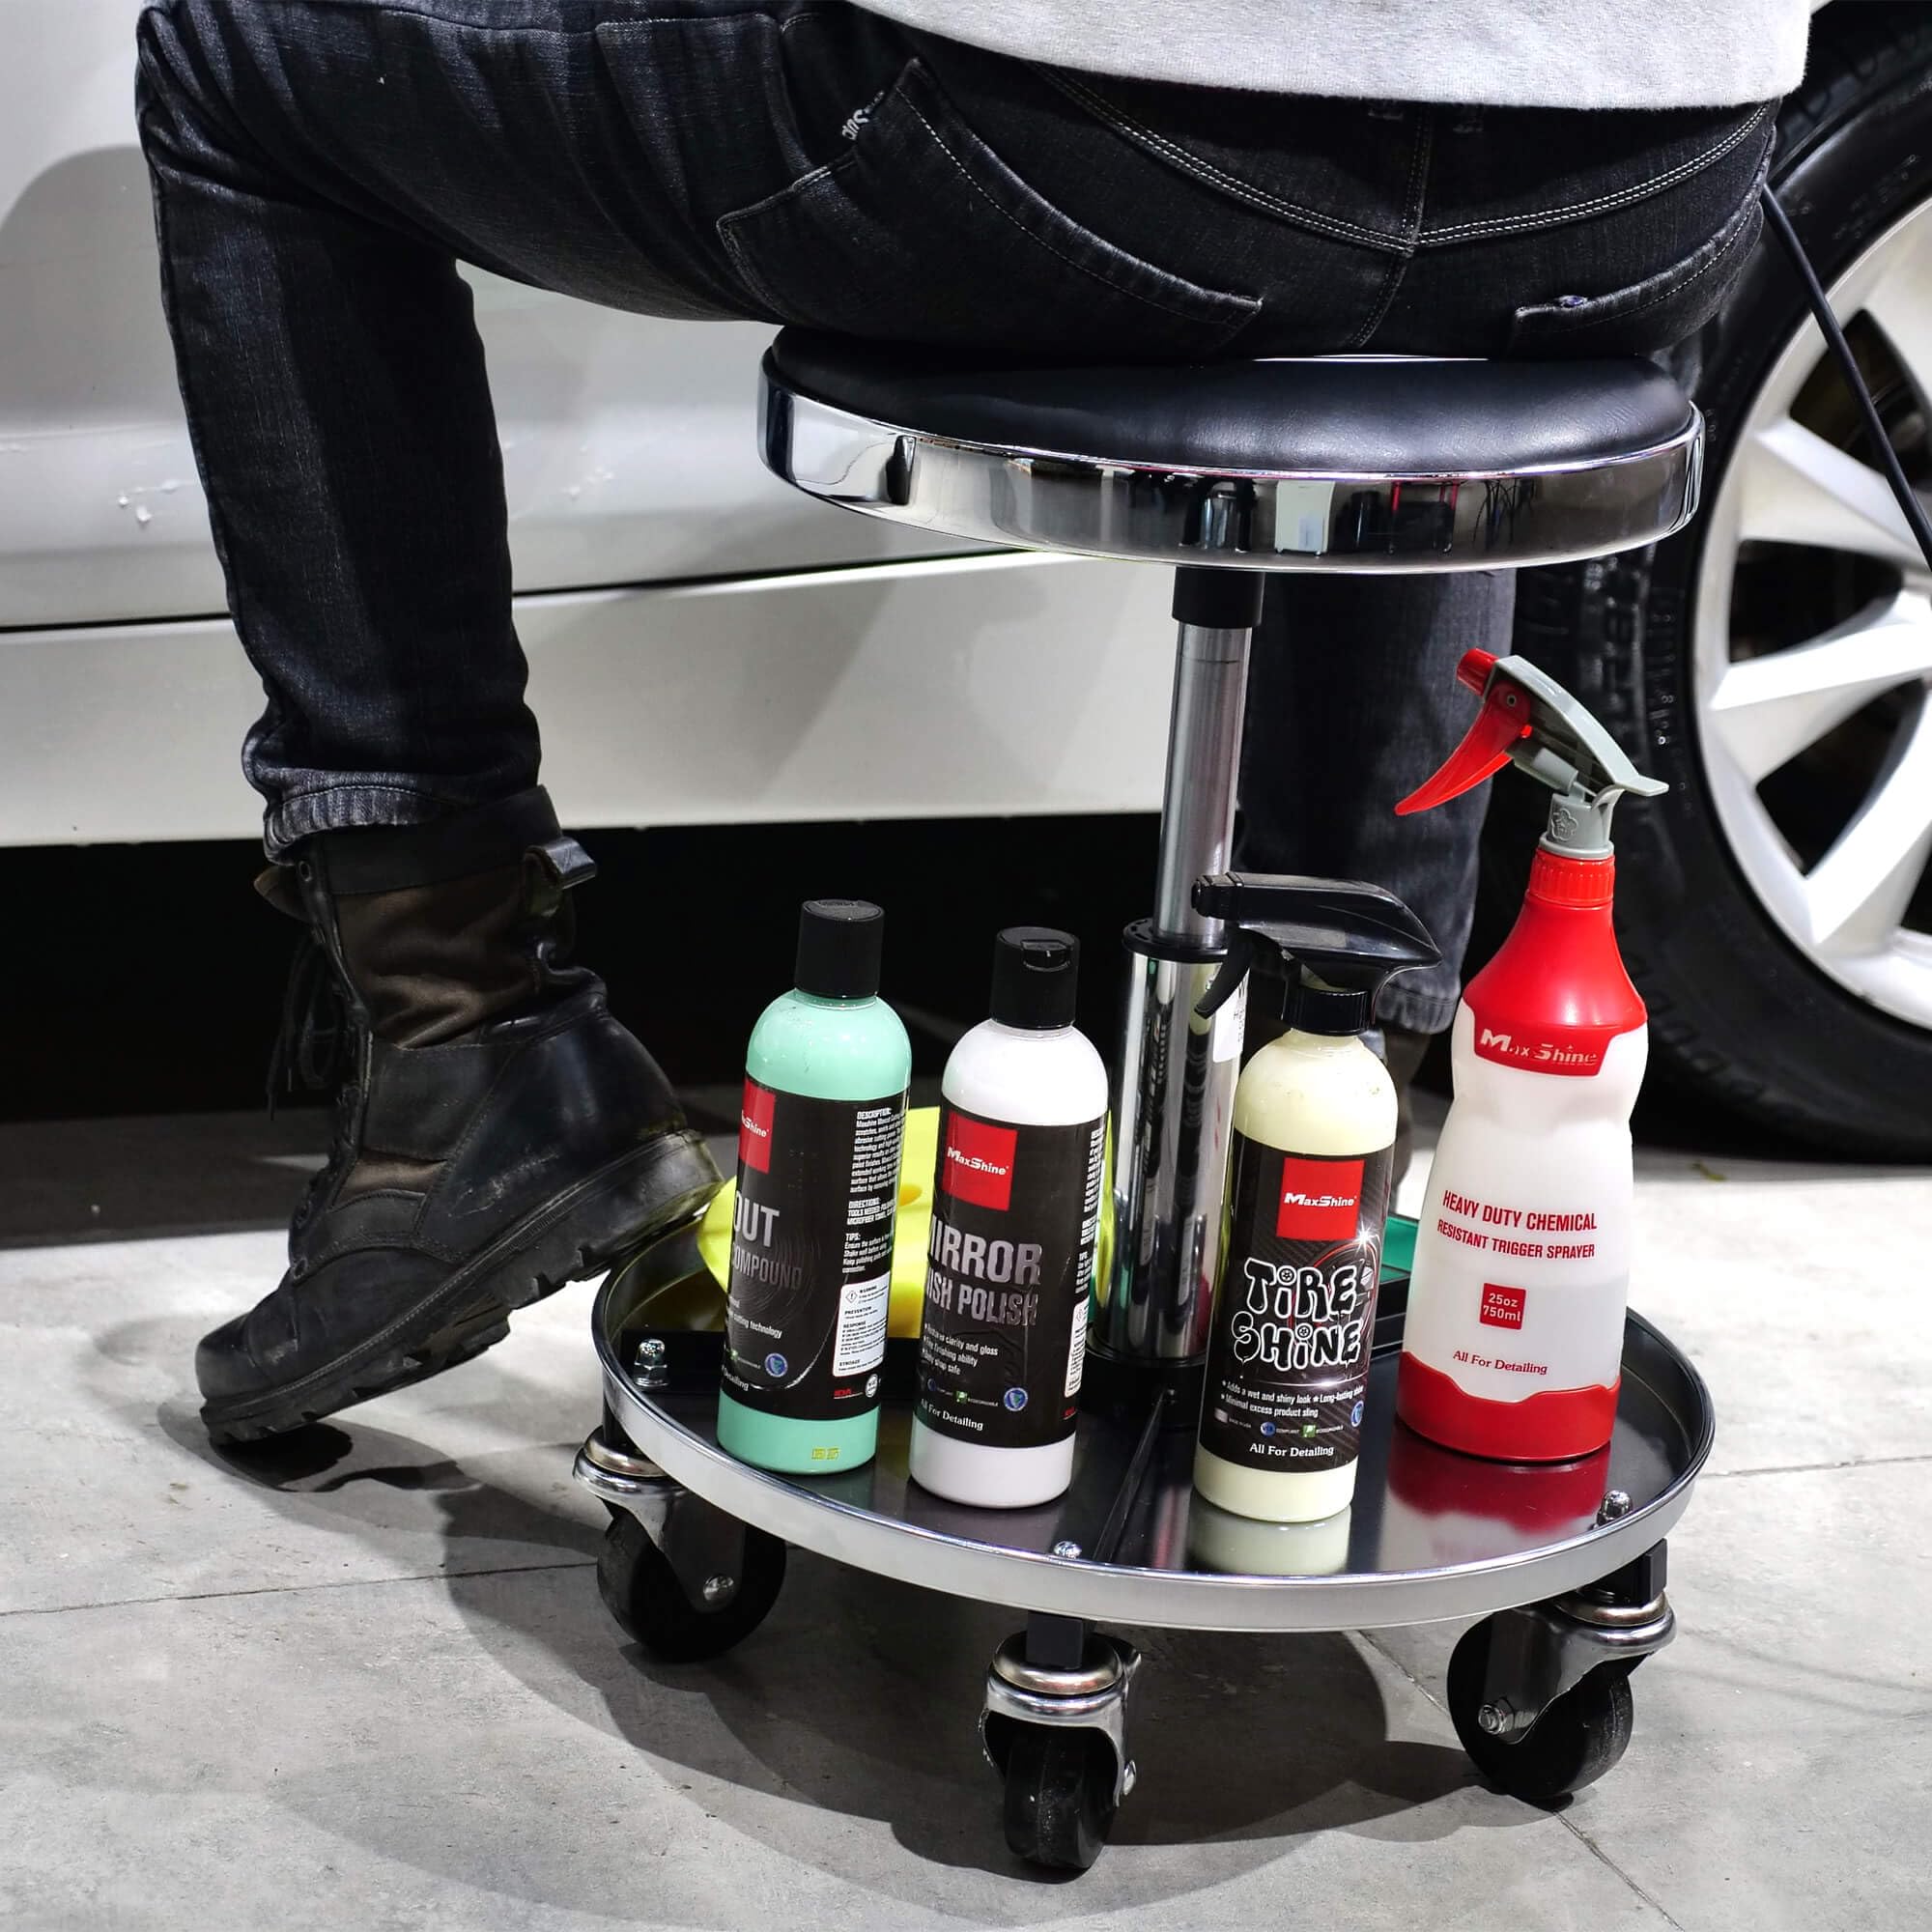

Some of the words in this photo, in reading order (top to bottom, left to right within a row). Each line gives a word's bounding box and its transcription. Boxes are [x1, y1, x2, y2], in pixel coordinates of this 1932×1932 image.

[948, 1147, 1006, 1176] MaxShine
[1284, 1193, 1355, 1207] MaxShine
[1442, 1190, 1479, 1218] HEAVY
[1483, 1205, 1521, 1228] DUTY
[1526, 1212, 1597, 1232] CHEMICAL
[1437, 1219, 1489, 1249] RESISTANT
[1492, 1238, 1543, 1258] TRIGGER
[1547, 1243, 1595, 1260] SPRAYER
[732, 1242, 802, 1291] OMPOUND
[958, 1284, 1038, 1325] POLISH
[1489, 1293, 1519, 1308] 25oz
[1483, 1305, 1521, 1322] 750ml
[750, 1320, 782, 1339] technology
[965, 1343, 979, 1352] and
[980, 1345, 998, 1355] gloss
[1453, 1350, 1468, 1363] All
[1471, 1355, 1492, 1368] For
[1494, 1359, 1548, 1376] Detailing
[1247, 1390, 1260, 1400] wet
[1262, 1392, 1275, 1402] and
[1276, 1393, 1295, 1406] shiny
[1296, 1394, 1311, 1404] look
[928, 1404, 941, 1417] For
[943, 1410, 983, 1431] Detailing
[1249, 1404, 1273, 1415] excess
[1273, 1406, 1301, 1417] product
[1302, 1407, 1319, 1418] sling
[1249, 1443, 1264, 1454] All
[1268, 1445, 1286, 1457] For
[1289, 1445, 1334, 1457] Detailing
